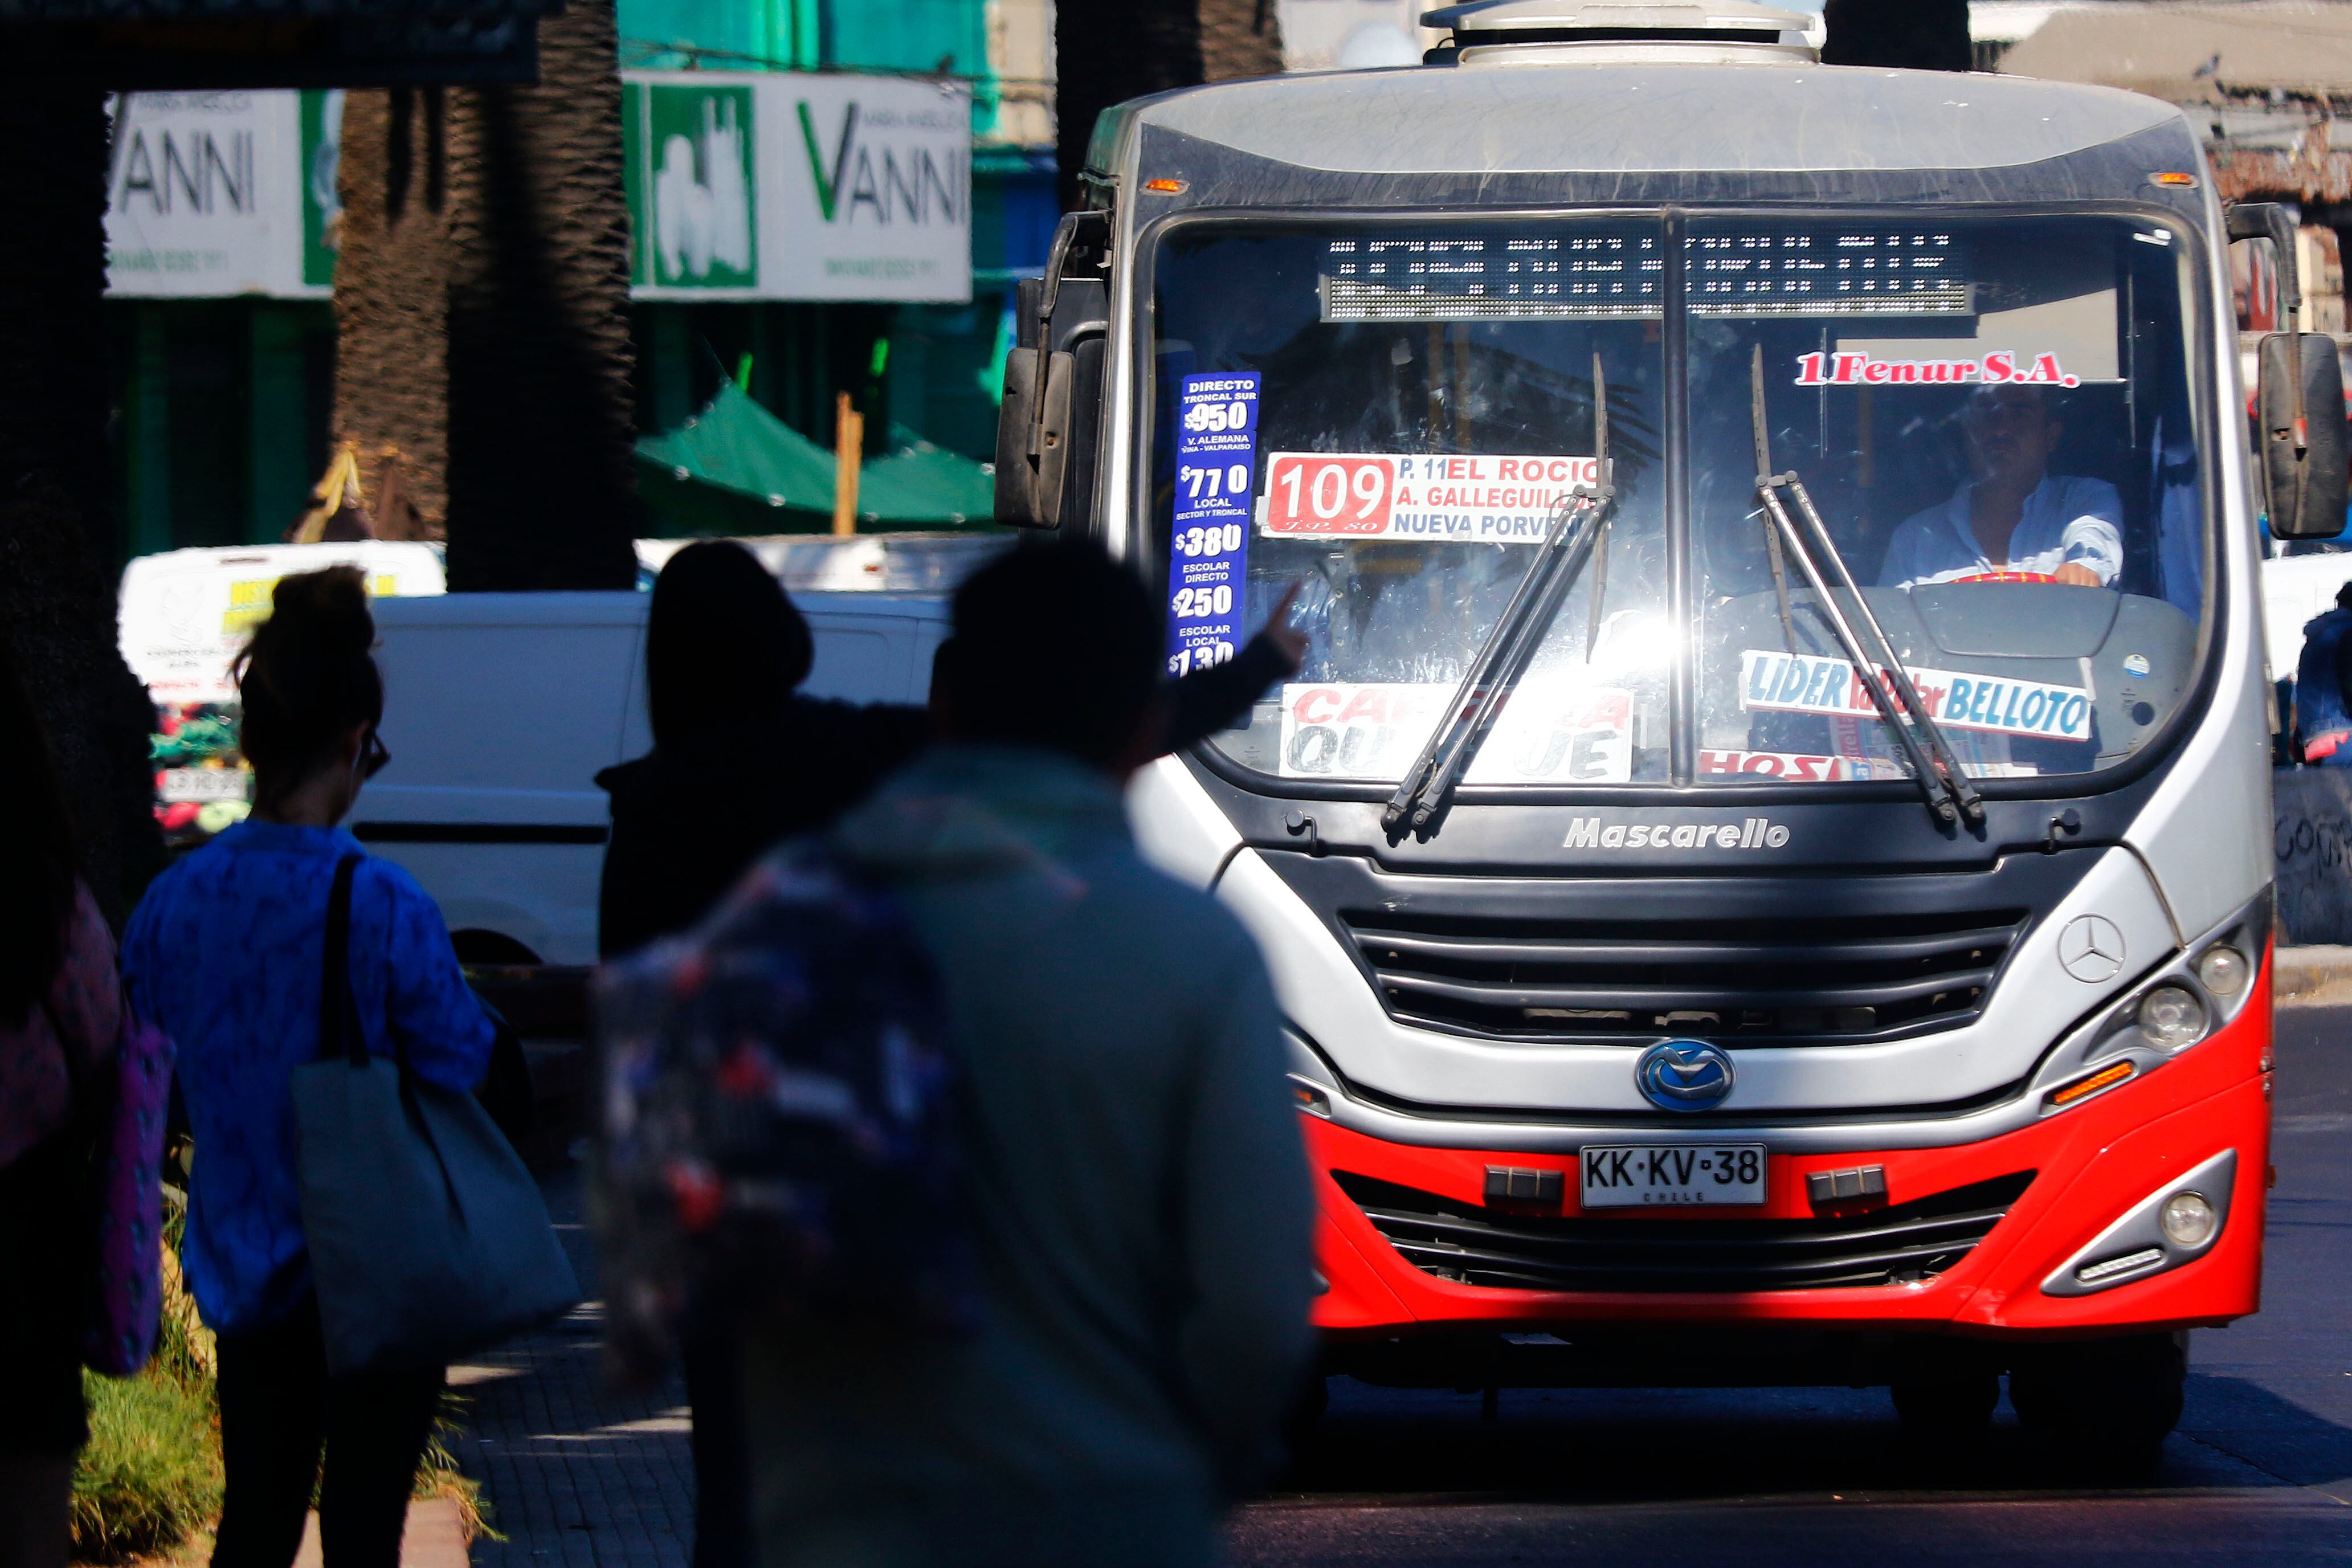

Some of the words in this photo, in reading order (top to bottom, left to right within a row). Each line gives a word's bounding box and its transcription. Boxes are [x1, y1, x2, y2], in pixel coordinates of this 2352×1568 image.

[797, 101, 968, 224] VANNI
[1833, 352, 1979, 385] Fenur
[1189, 379, 1255, 394] DIRECTO
[1183, 393, 1232, 404] TRONCAL
[1234, 392, 1257, 401] SUR
[1184, 401, 1248, 432] $950
[1187, 437, 1197, 446] V.
[1197, 434, 1250, 444] ALEMANA
[1399, 458, 1415, 479] P.
[1424, 458, 1448, 480] 11
[1448, 458, 1485, 480] EL
[1281, 464, 1385, 520] 109
[1396, 486, 1419, 506] A.
[1427, 487, 1595, 509] GALLEGUILL
[1194, 497, 1232, 509] LOCAL
[1176, 510, 1205, 521] SECTOR
[1211, 508, 1248, 517] TRONCAL
[1394, 513, 1473, 534] NUEVA
[1342, 521, 1378, 531] 80
[1175, 523, 1243, 557] $380
[1183, 561, 1231, 573] ESCOLAR
[1185, 572, 1229, 583] DIRECTO
[1172, 585, 1233, 619] $250
[1179, 624, 1231, 637] ESCOLAR
[1186, 636, 1221, 647] LOCAL
[1748, 656, 1849, 707] LIDER
[1943, 677, 2088, 734] BELLOTO
[1563, 817, 1791, 848] Mascarello
[1644, 1192, 1704, 1202] CHILE
